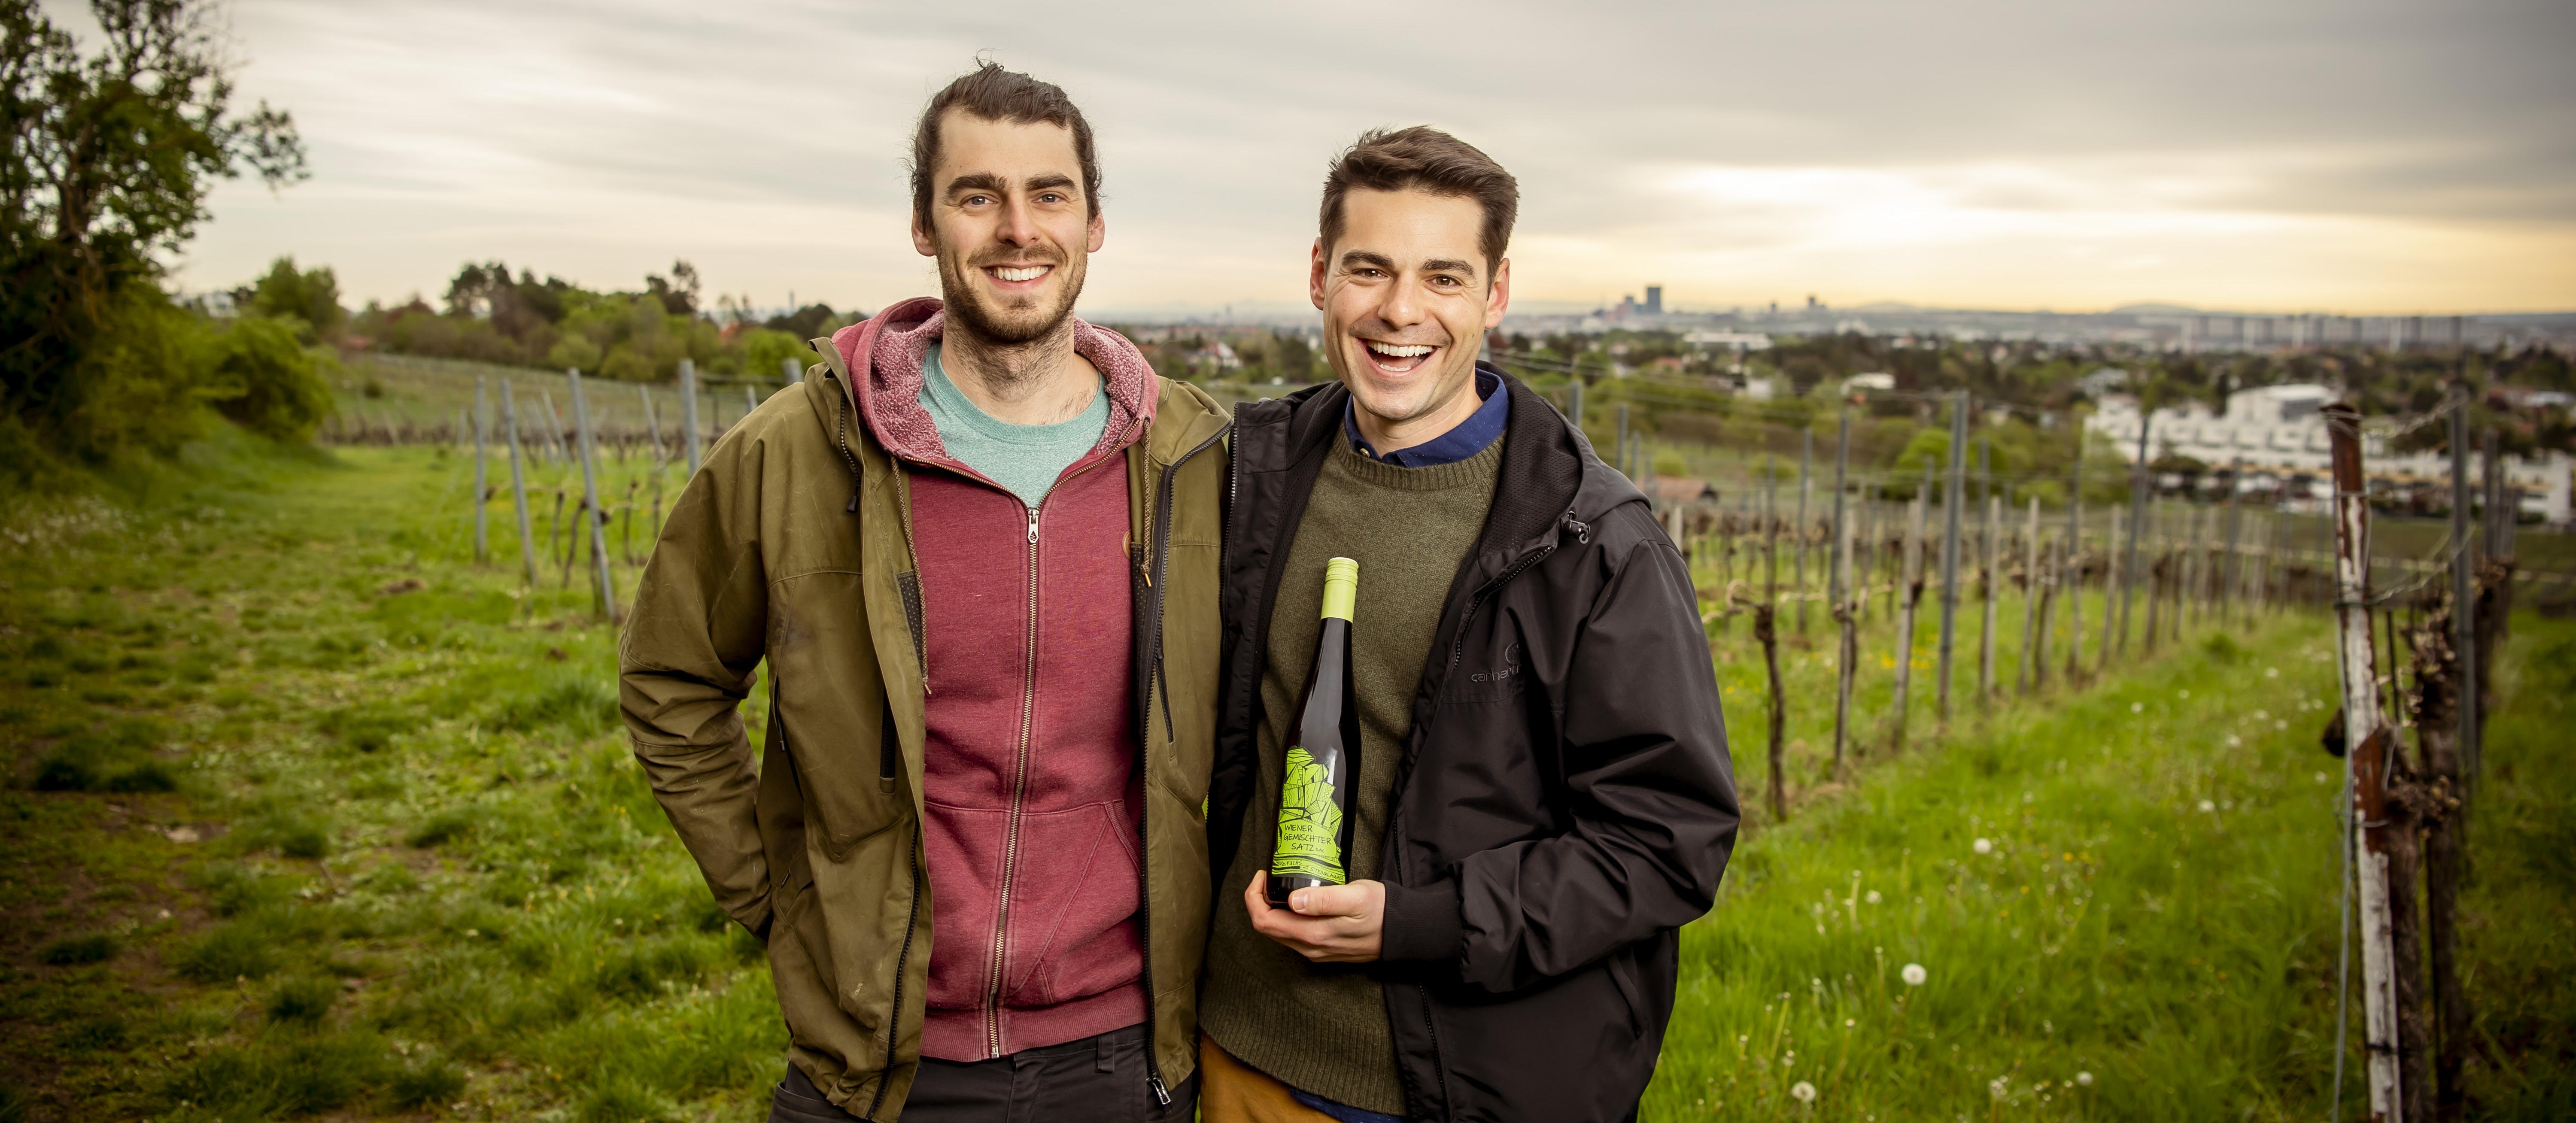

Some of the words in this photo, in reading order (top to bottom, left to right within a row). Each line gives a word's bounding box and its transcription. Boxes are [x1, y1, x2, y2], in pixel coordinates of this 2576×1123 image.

[1285, 824, 1312, 832] WIENER
[1284, 833, 1331, 845] GEMISCHTER
[1291, 843, 1314, 851] SATZ
